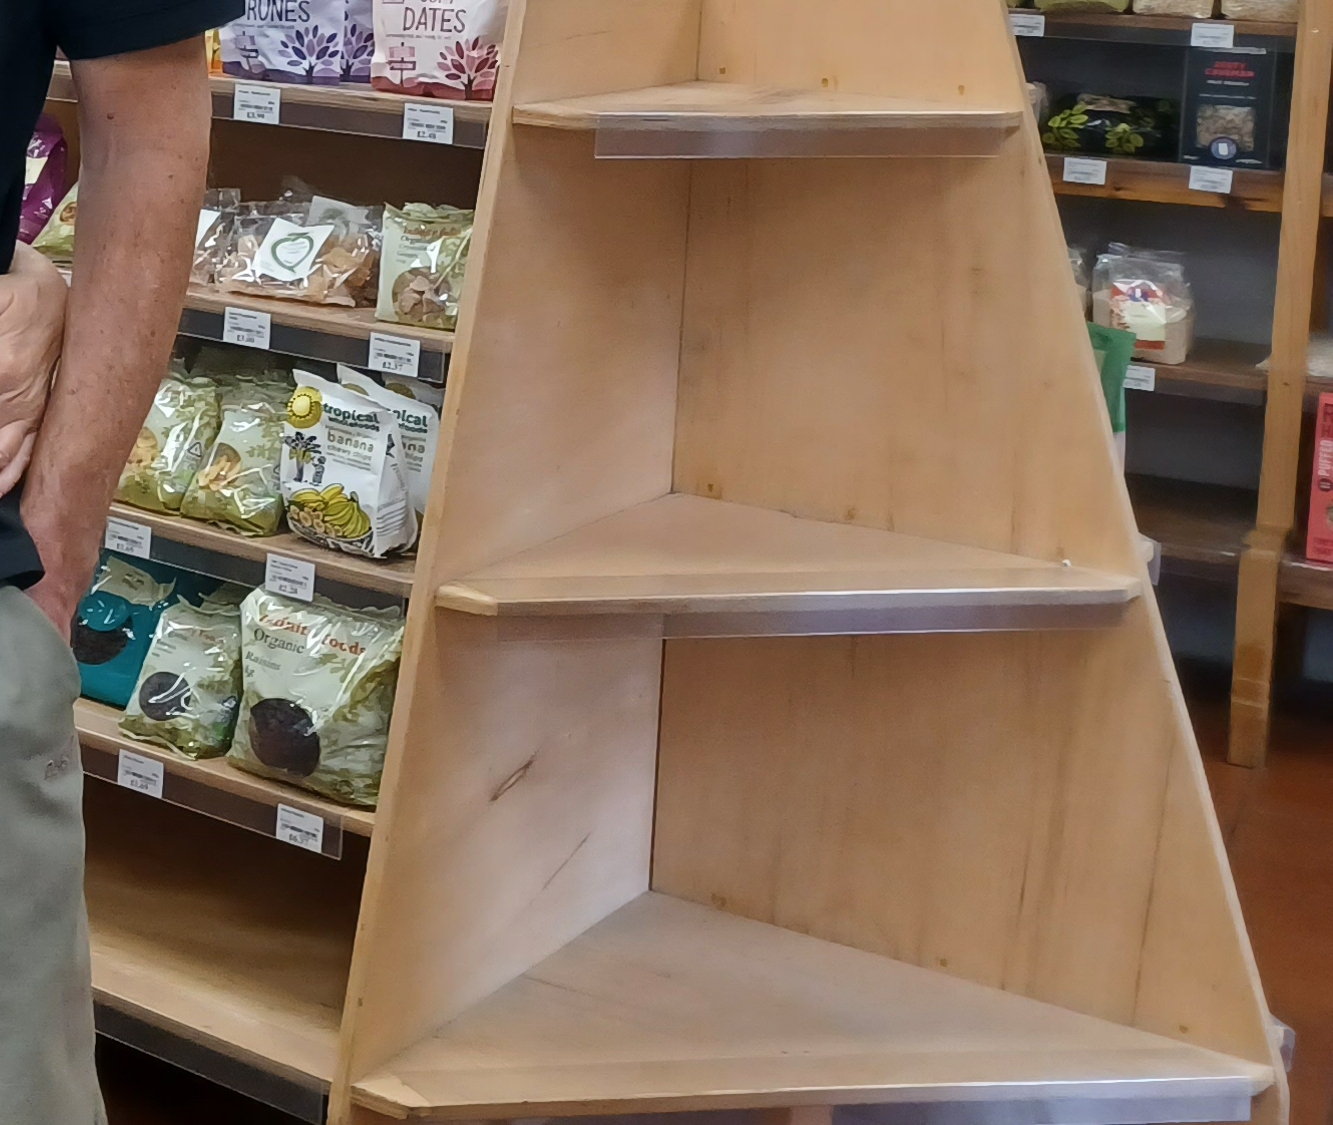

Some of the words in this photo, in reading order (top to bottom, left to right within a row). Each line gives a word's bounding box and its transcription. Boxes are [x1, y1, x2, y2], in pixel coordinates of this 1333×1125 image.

[402, 7, 467, 34] DATES
[323, 402, 380, 424] tropical
[327, 430, 374, 452] banana
[253, 627, 305, 655] Organic
